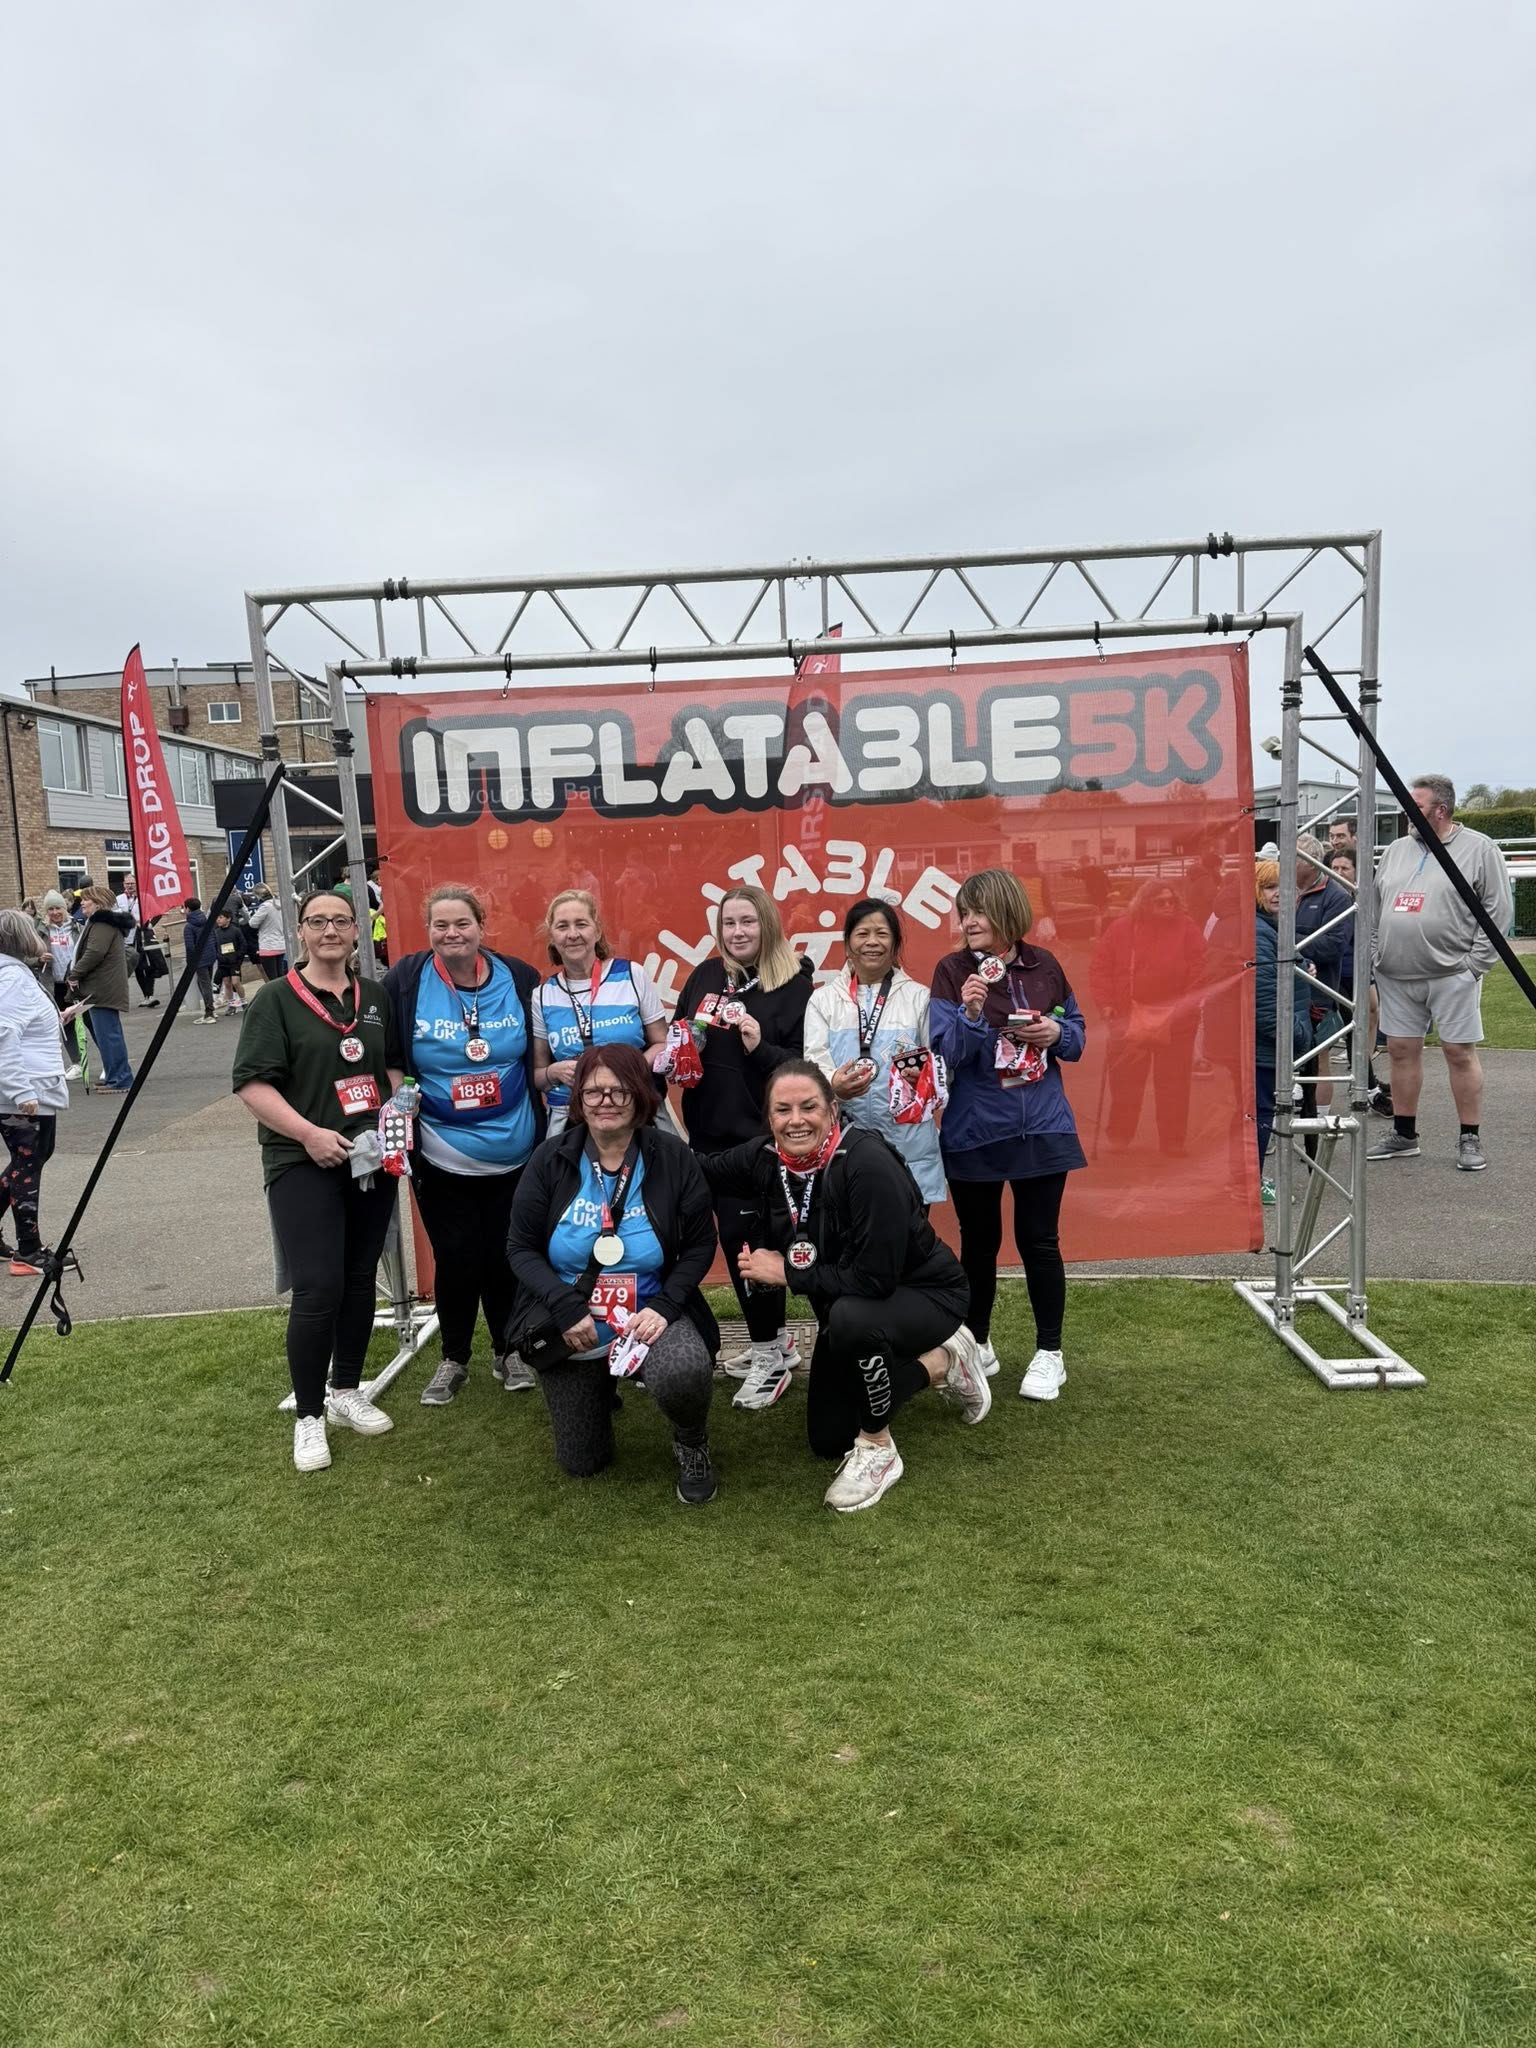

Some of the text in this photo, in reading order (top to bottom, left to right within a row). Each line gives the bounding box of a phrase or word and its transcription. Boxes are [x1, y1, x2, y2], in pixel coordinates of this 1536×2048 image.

[563, 781, 604, 801] Bar
[129, 711, 182, 897] BAG DROP
[1399, 897, 1421, 906] 1425
[984, 963, 1002, 979] 5K
[726, 1009, 741, 1019] 5K
[434, 1014, 519, 1032] Parknson's
[433, 1028, 456, 1040] UK
[562, 1033, 583, 1046] UK
[345, 1046, 361, 1057] 5K
[470, 1046, 487, 1057] 5K
[346, 1085, 375, 1101] 1881
[458, 1081, 495, 1099] 1883
[573, 1211, 597, 1228] UK
[793, 1251, 811, 1262] 5K
[590, 1287, 628, 1304] 879
[858, 1355, 891, 1417] GUESS
